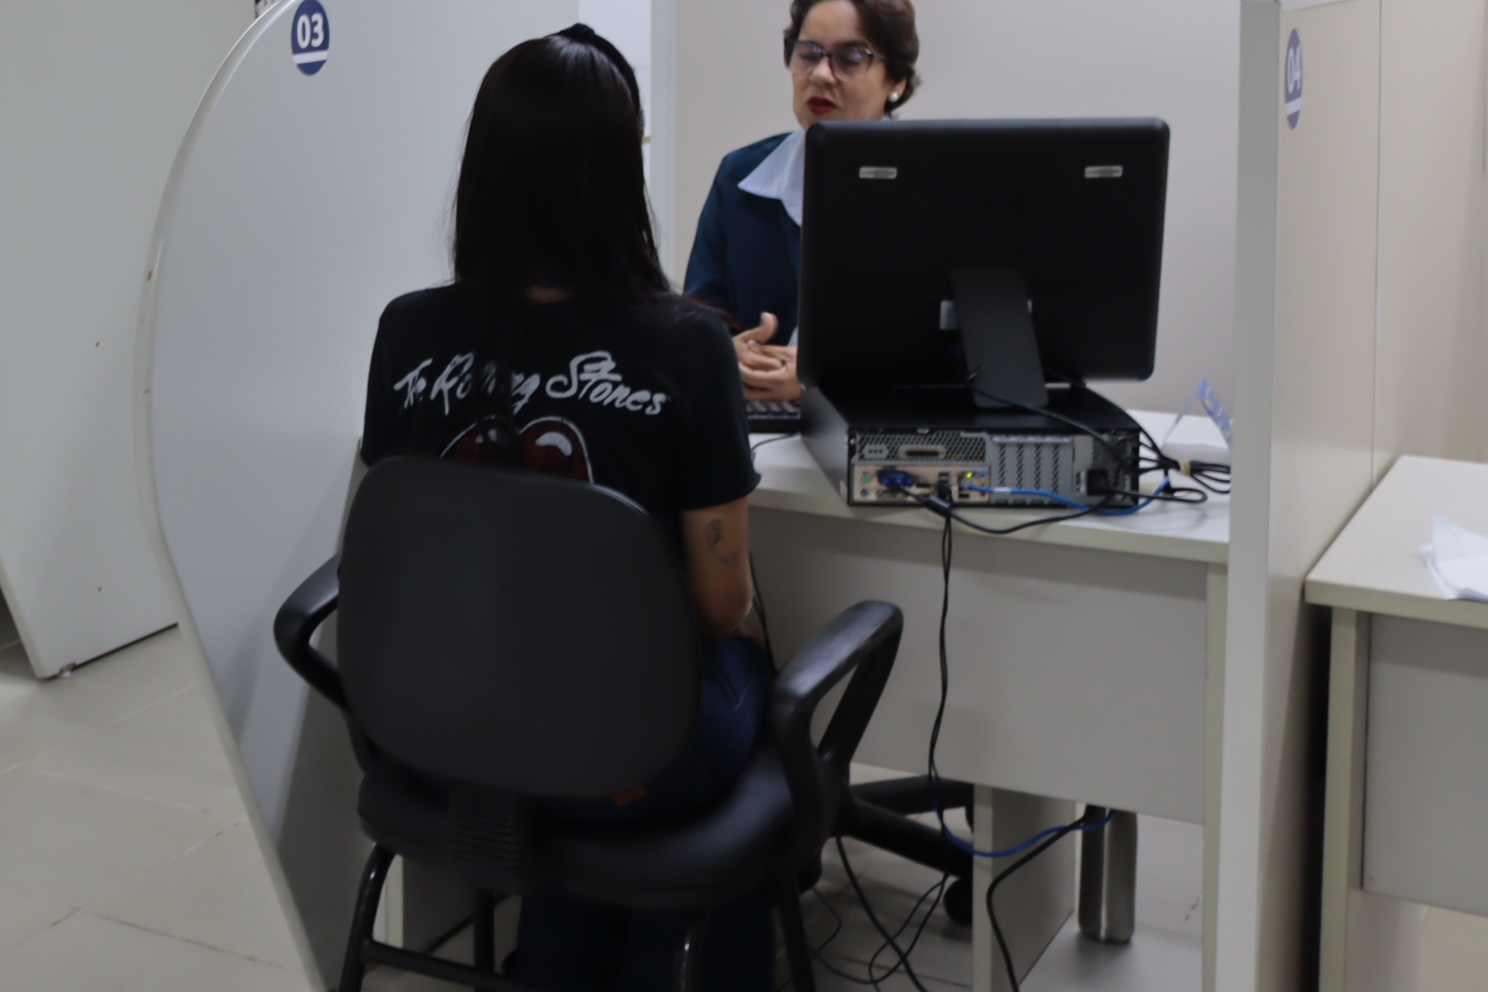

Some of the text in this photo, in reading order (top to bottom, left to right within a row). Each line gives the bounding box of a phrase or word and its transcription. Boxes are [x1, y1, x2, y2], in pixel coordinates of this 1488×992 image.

[297, 12, 324, 49] 03
[1287, 46, 1301, 94] 04
[430, 352, 541, 415] Rong
[545, 350, 667, 415] Stones
